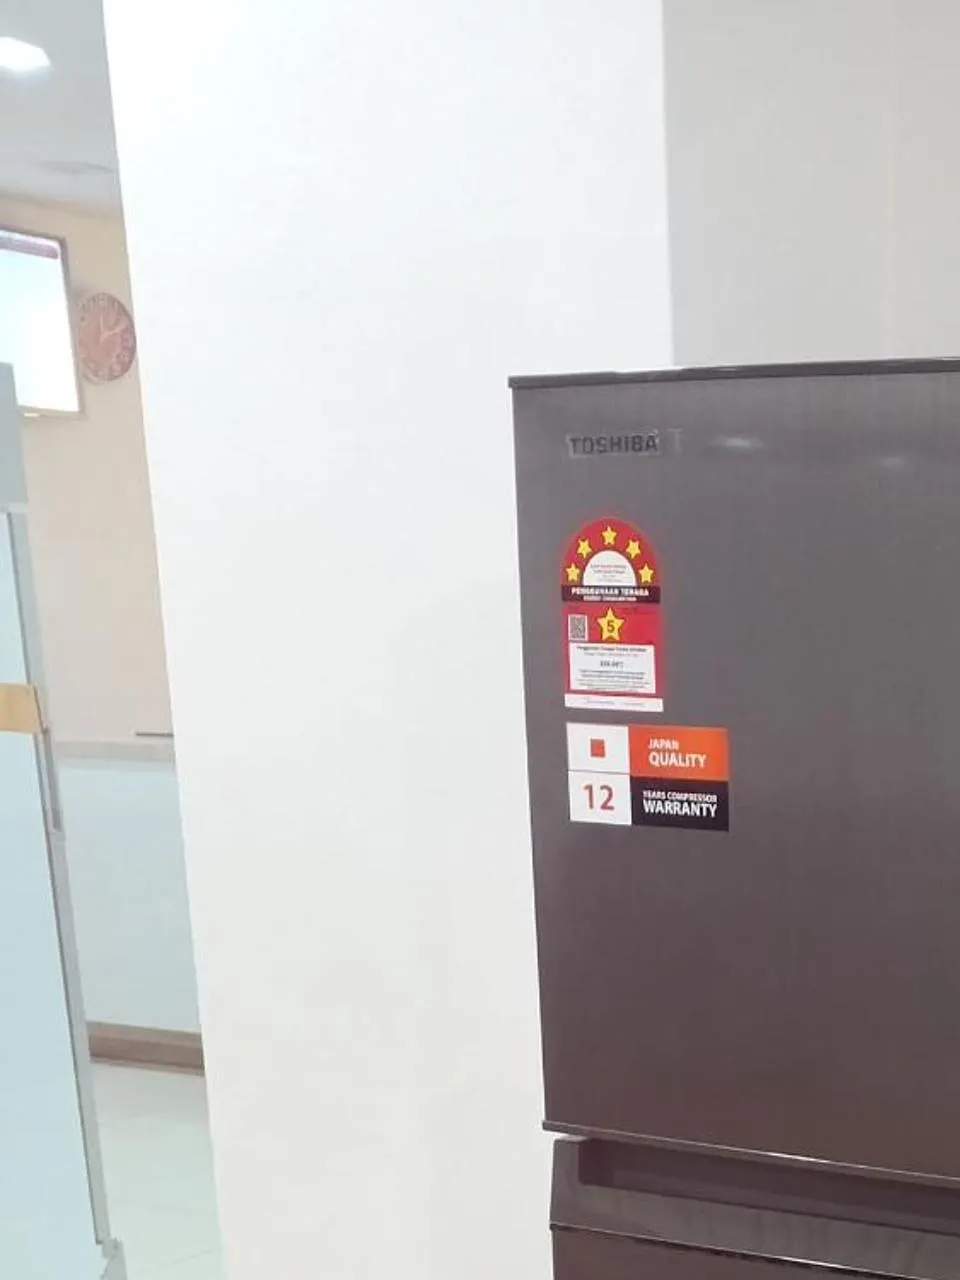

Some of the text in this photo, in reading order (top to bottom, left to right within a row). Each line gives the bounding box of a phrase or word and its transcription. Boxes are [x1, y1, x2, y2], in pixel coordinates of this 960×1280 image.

[570, 434, 658, 455] TOSHIBA
[607, 620, 615, 633] 5
[648, 739, 679, 750] JAPAN
[649, 753, 707, 767] QUALITY
[584, 784, 615, 811] 12
[643, 791, 718, 803] YEARS COMPRESSOR
[643, 800, 717, 817] WARRANTY
